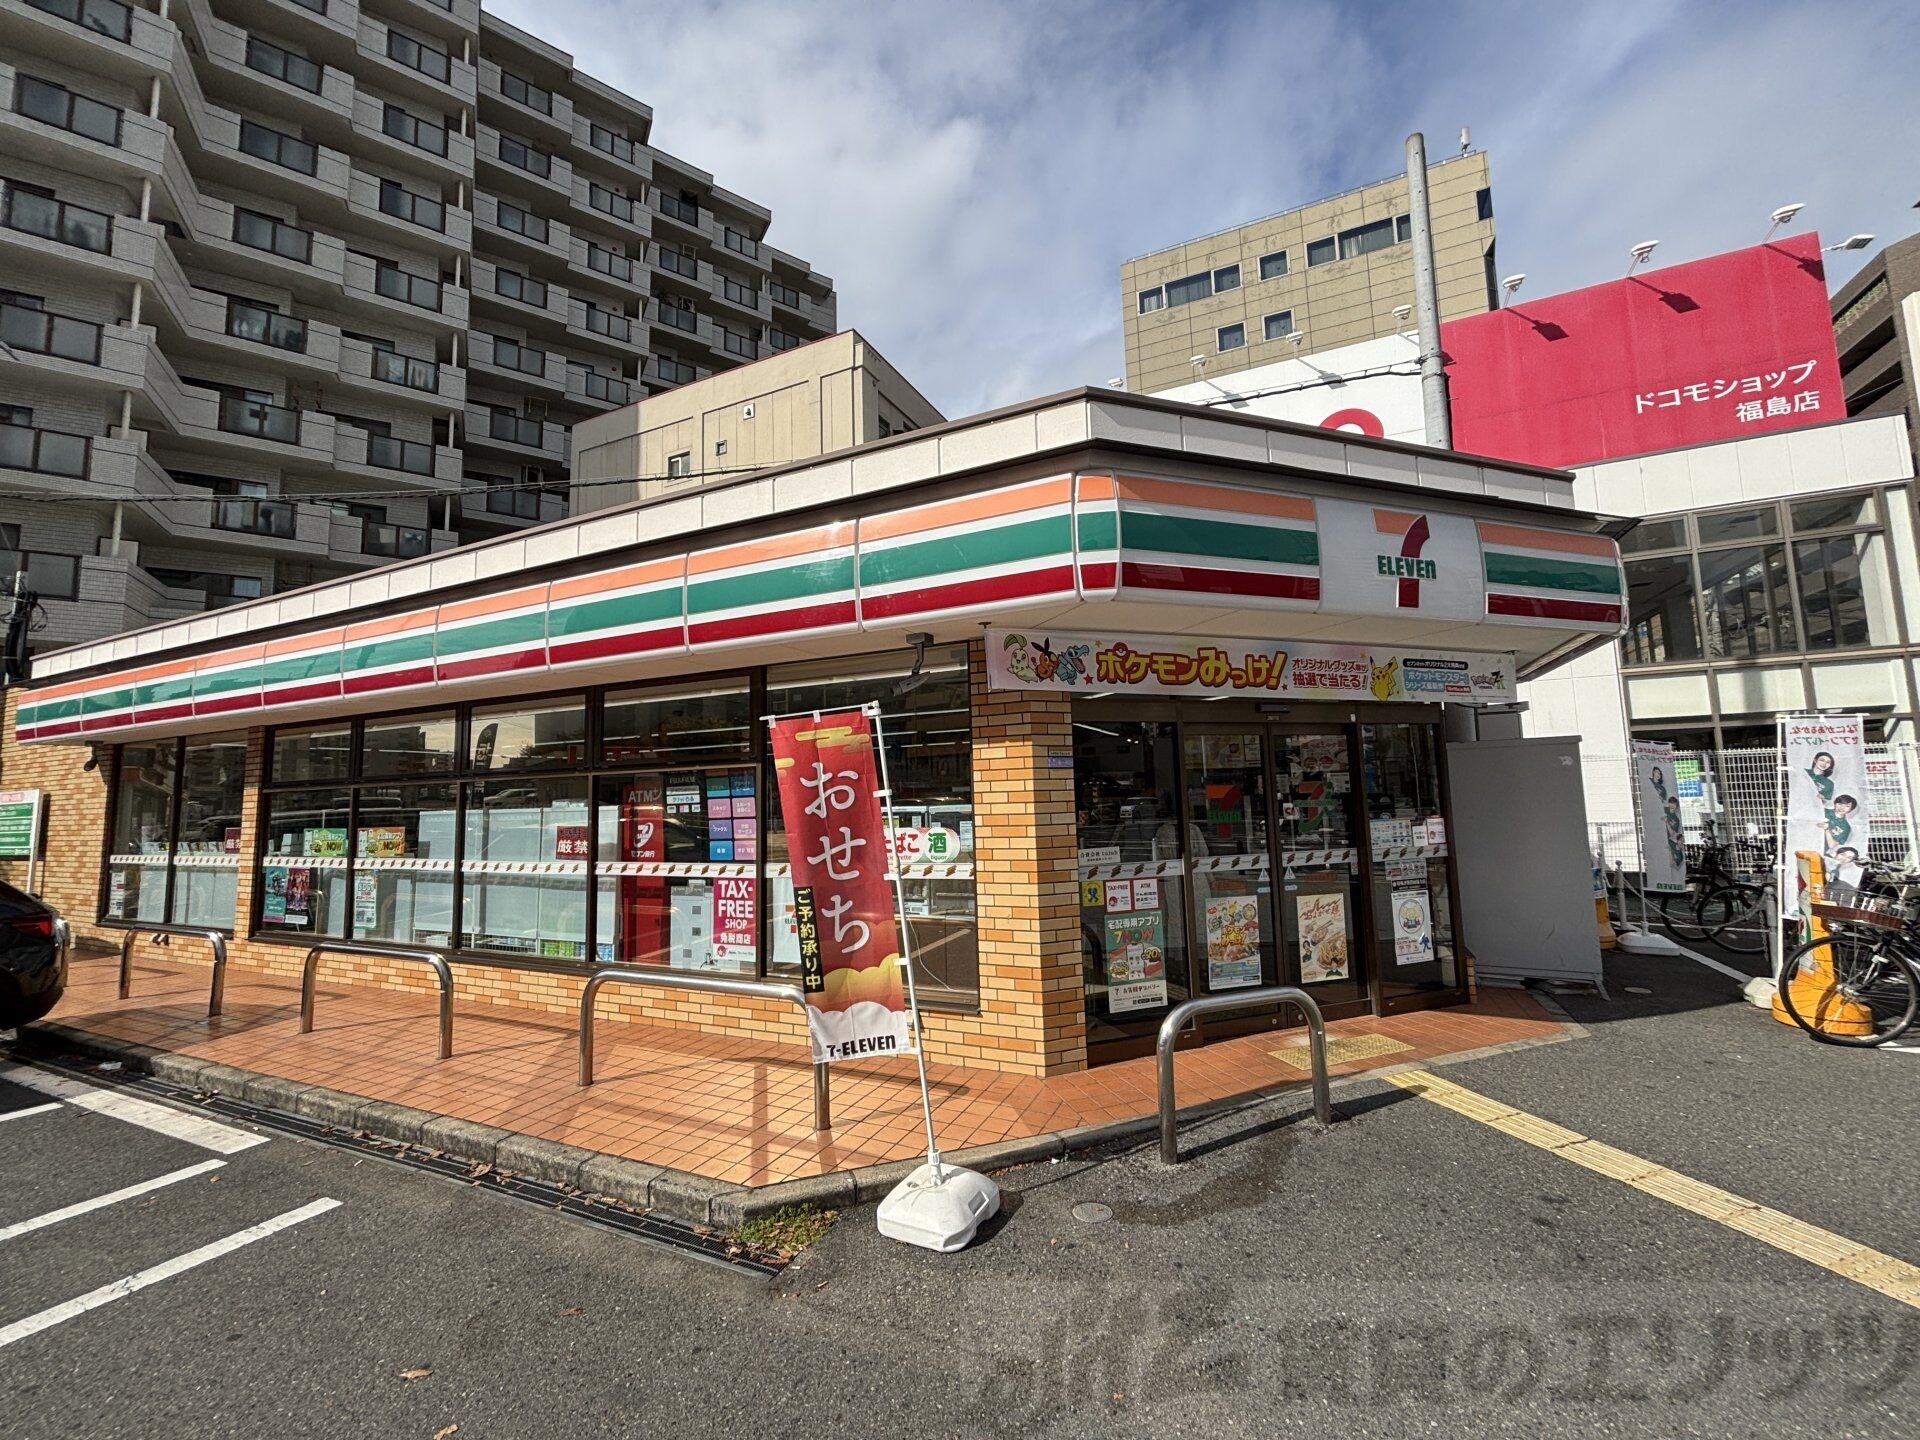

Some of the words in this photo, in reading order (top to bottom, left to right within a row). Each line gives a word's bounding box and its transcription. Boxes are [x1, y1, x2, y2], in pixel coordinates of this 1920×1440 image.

[1635, 359, 1818, 415] ドコモショップ
[1736, 389, 1821, 423] 福島店
[1377, 554, 1437, 580] ELEVEN
[1096, 643, 1288, 690] ポケモンみっけ!
[1292, 671, 1368, 690] 抽選で当たる!
[557, 839, 588, 854] 厳禁
[928, 832, 947, 853] 酒
[800, 762, 870, 954] おせち
[718, 880, 753, 899] TAX-
[718, 900, 754, 918] FREE
[725, 919, 748, 929] SHOP
[797, 888, 822, 989] ご予約承り中
[826, 1034, 896, 1057] 7-ELEVEN
